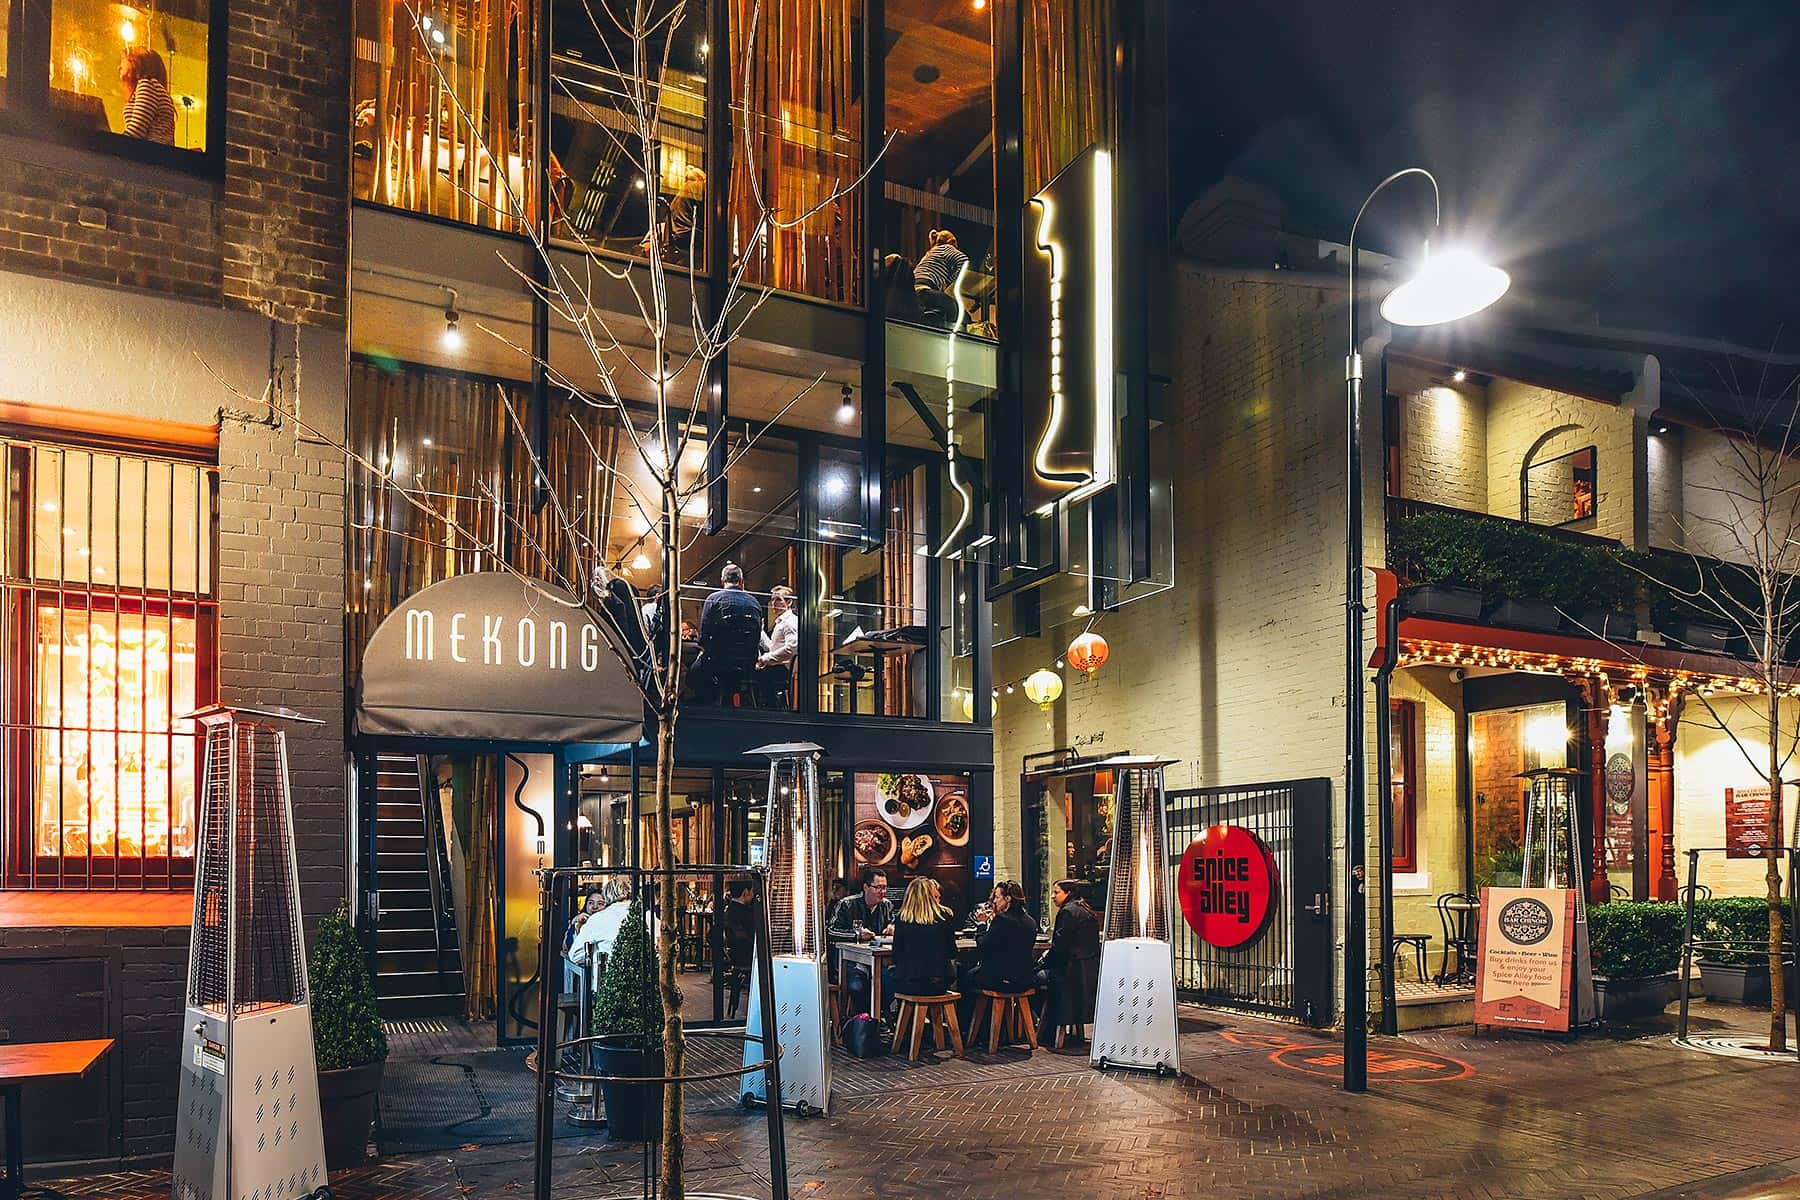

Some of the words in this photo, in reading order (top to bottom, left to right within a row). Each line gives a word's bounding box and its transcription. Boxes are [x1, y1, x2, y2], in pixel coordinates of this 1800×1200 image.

[405, 608, 599, 672] MEKONG
[1194, 849, 1249, 889] spice
[1200, 882, 1250, 924] alley
[1492, 970, 1512, 978] Spice
[1514, 972, 1533, 980] Alley
